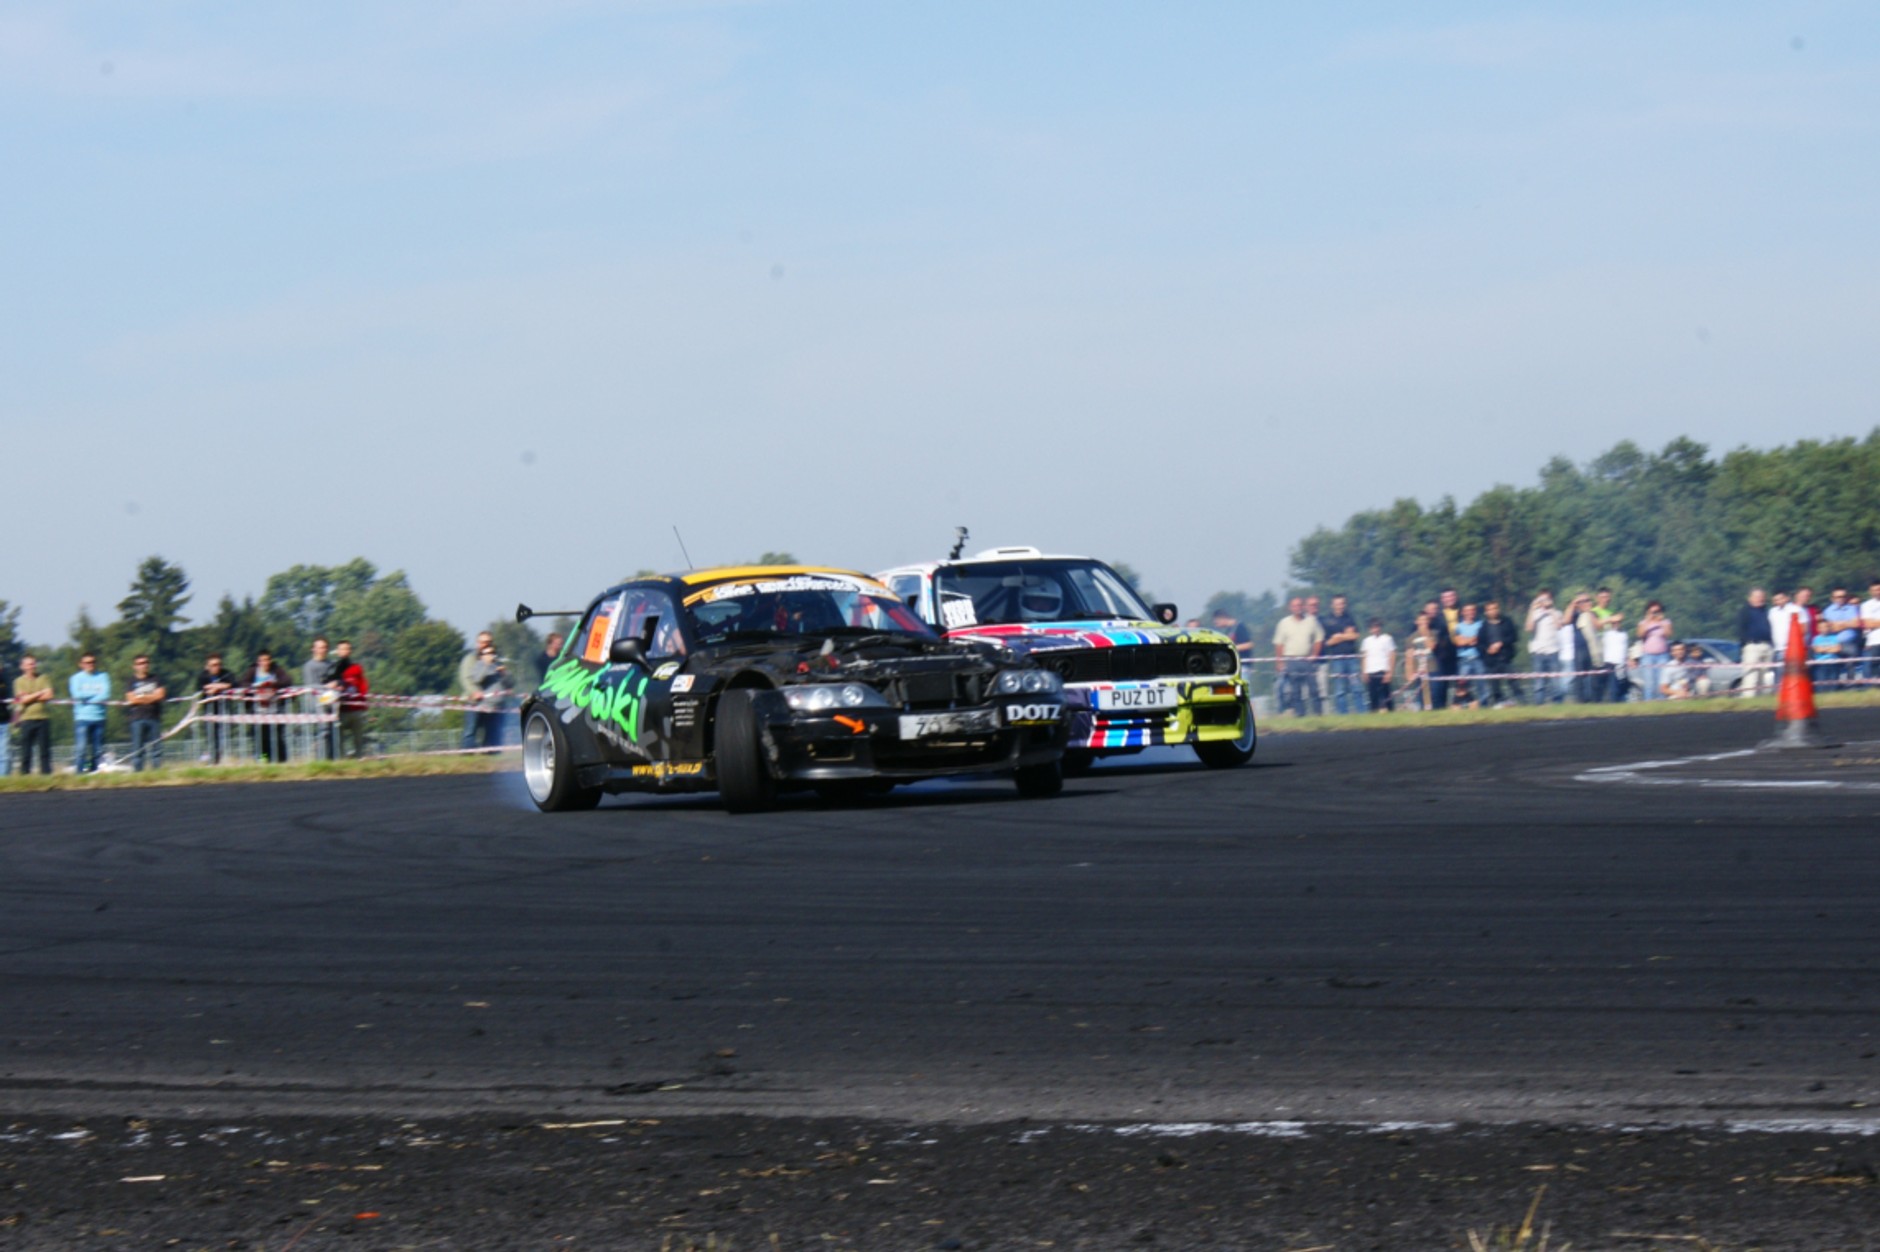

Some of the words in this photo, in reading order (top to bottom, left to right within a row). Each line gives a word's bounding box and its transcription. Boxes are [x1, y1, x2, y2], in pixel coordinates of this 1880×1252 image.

[1111, 690, 1142, 707] PUZ
[1147, 689, 1166, 705] DT
[1006, 704, 1062, 721] DOTZ
